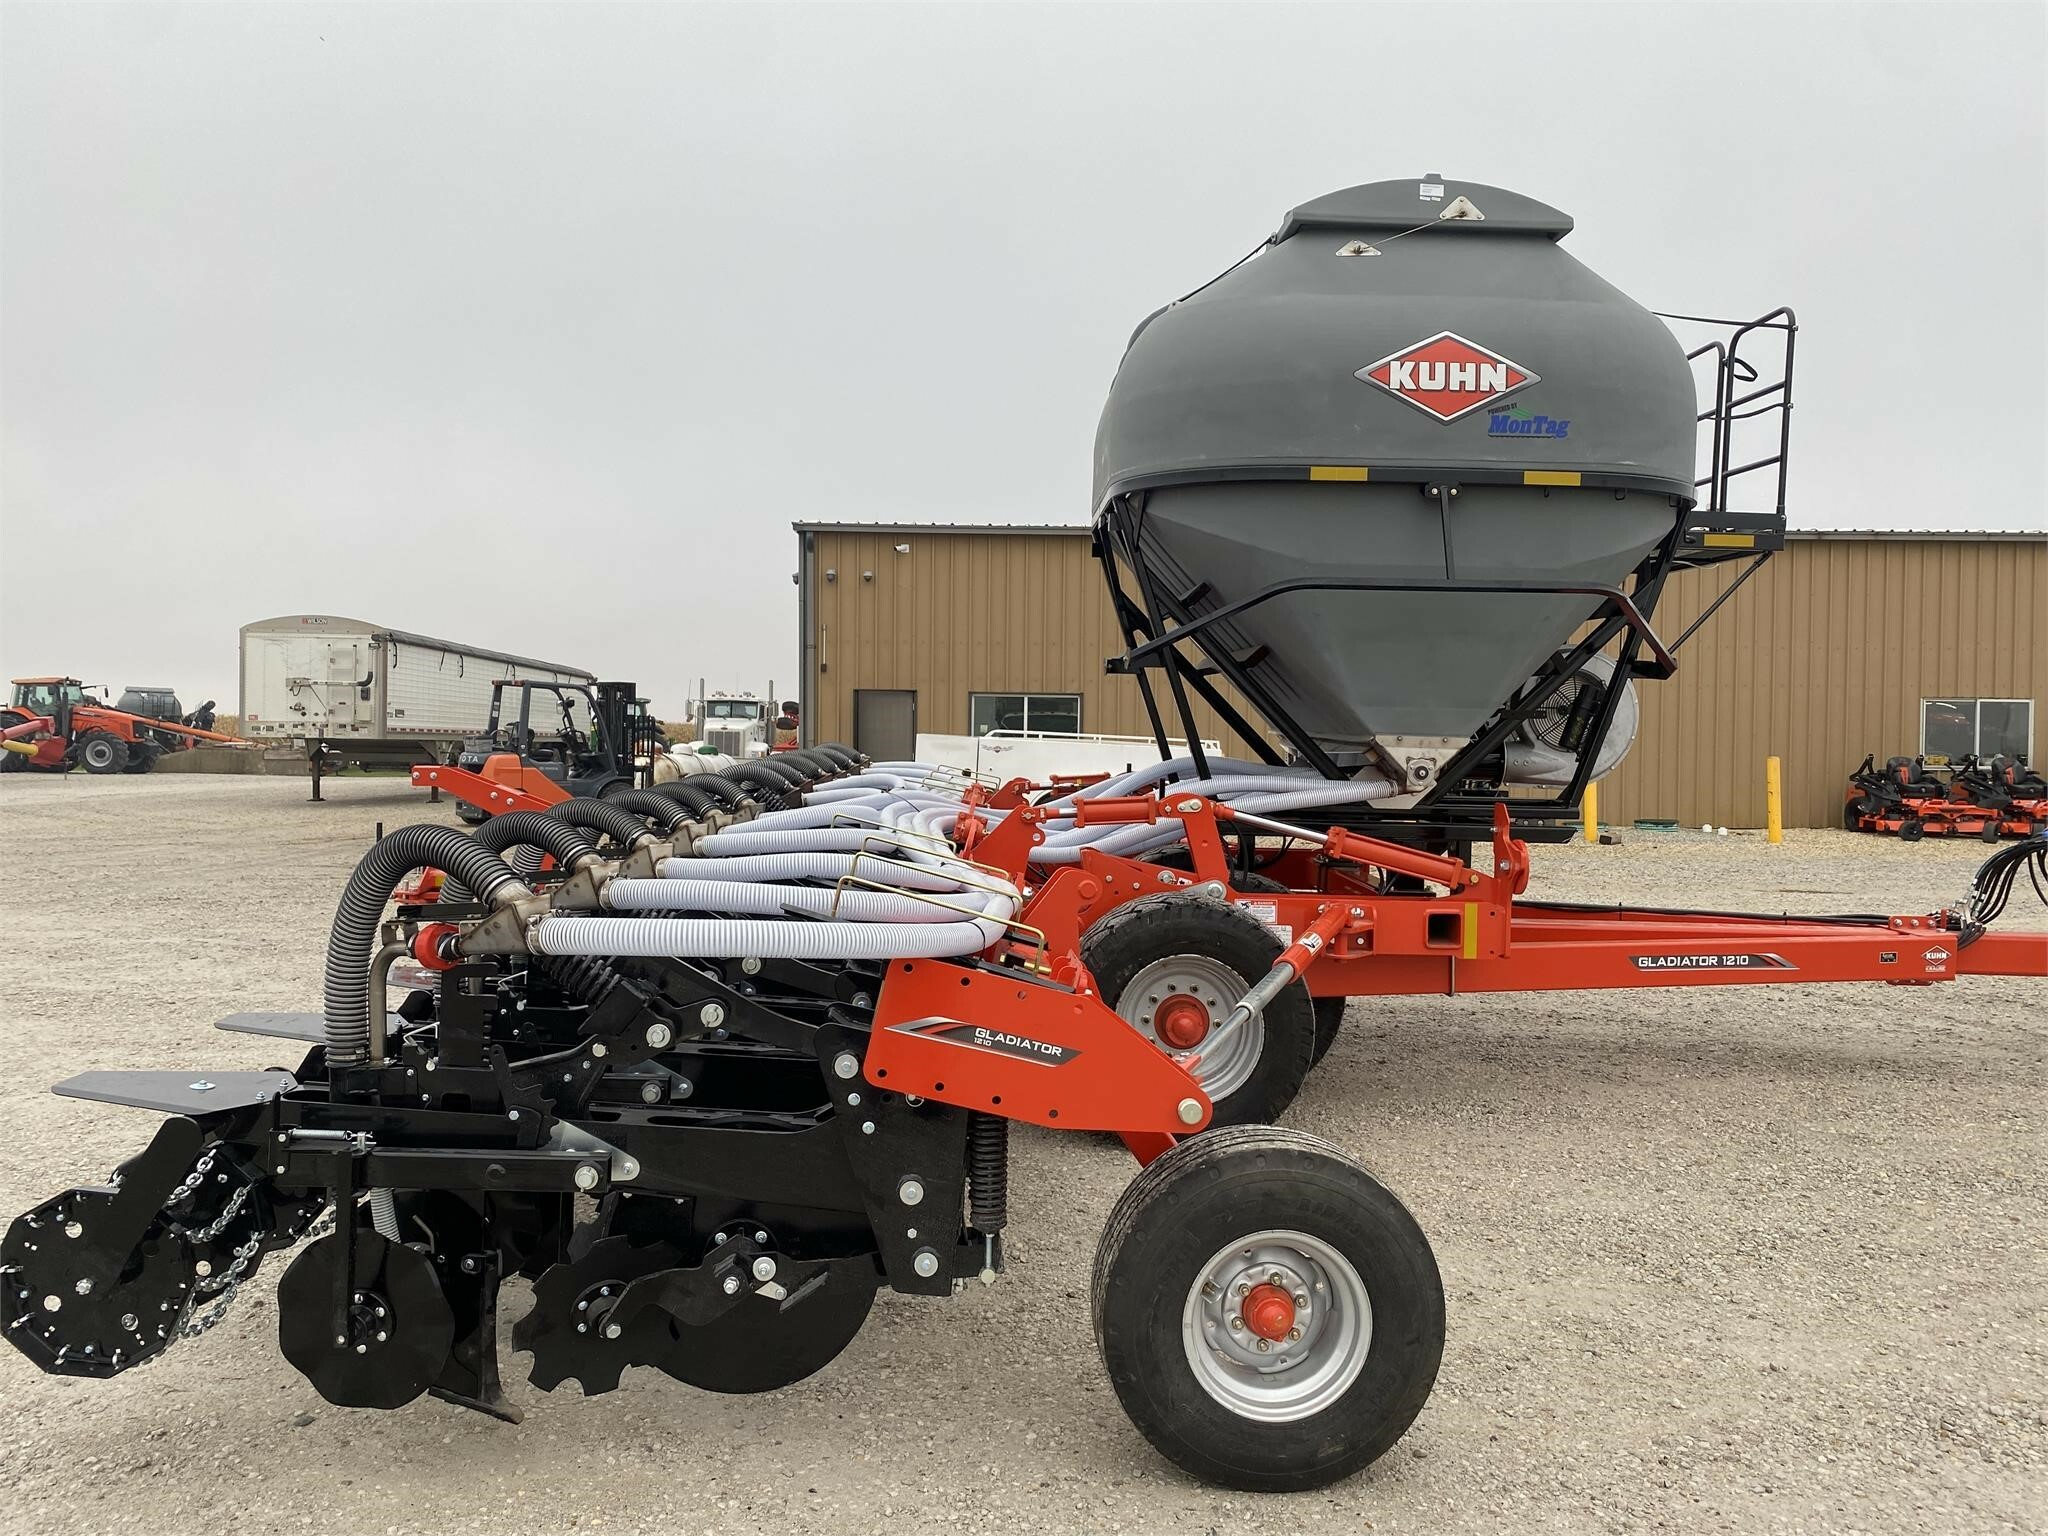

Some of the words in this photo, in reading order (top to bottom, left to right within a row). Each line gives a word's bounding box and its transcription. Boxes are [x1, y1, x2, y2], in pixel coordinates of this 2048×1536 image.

[1389, 360, 1507, 392] KUHN
[1488, 415, 1569, 438] MonTag
[1638, 956, 1718, 967] GLADIATOR
[1722, 955, 1749, 966] 1210
[974, 1037, 992, 1047] 1210
[975, 1027, 1063, 1057] GLADIATOR
